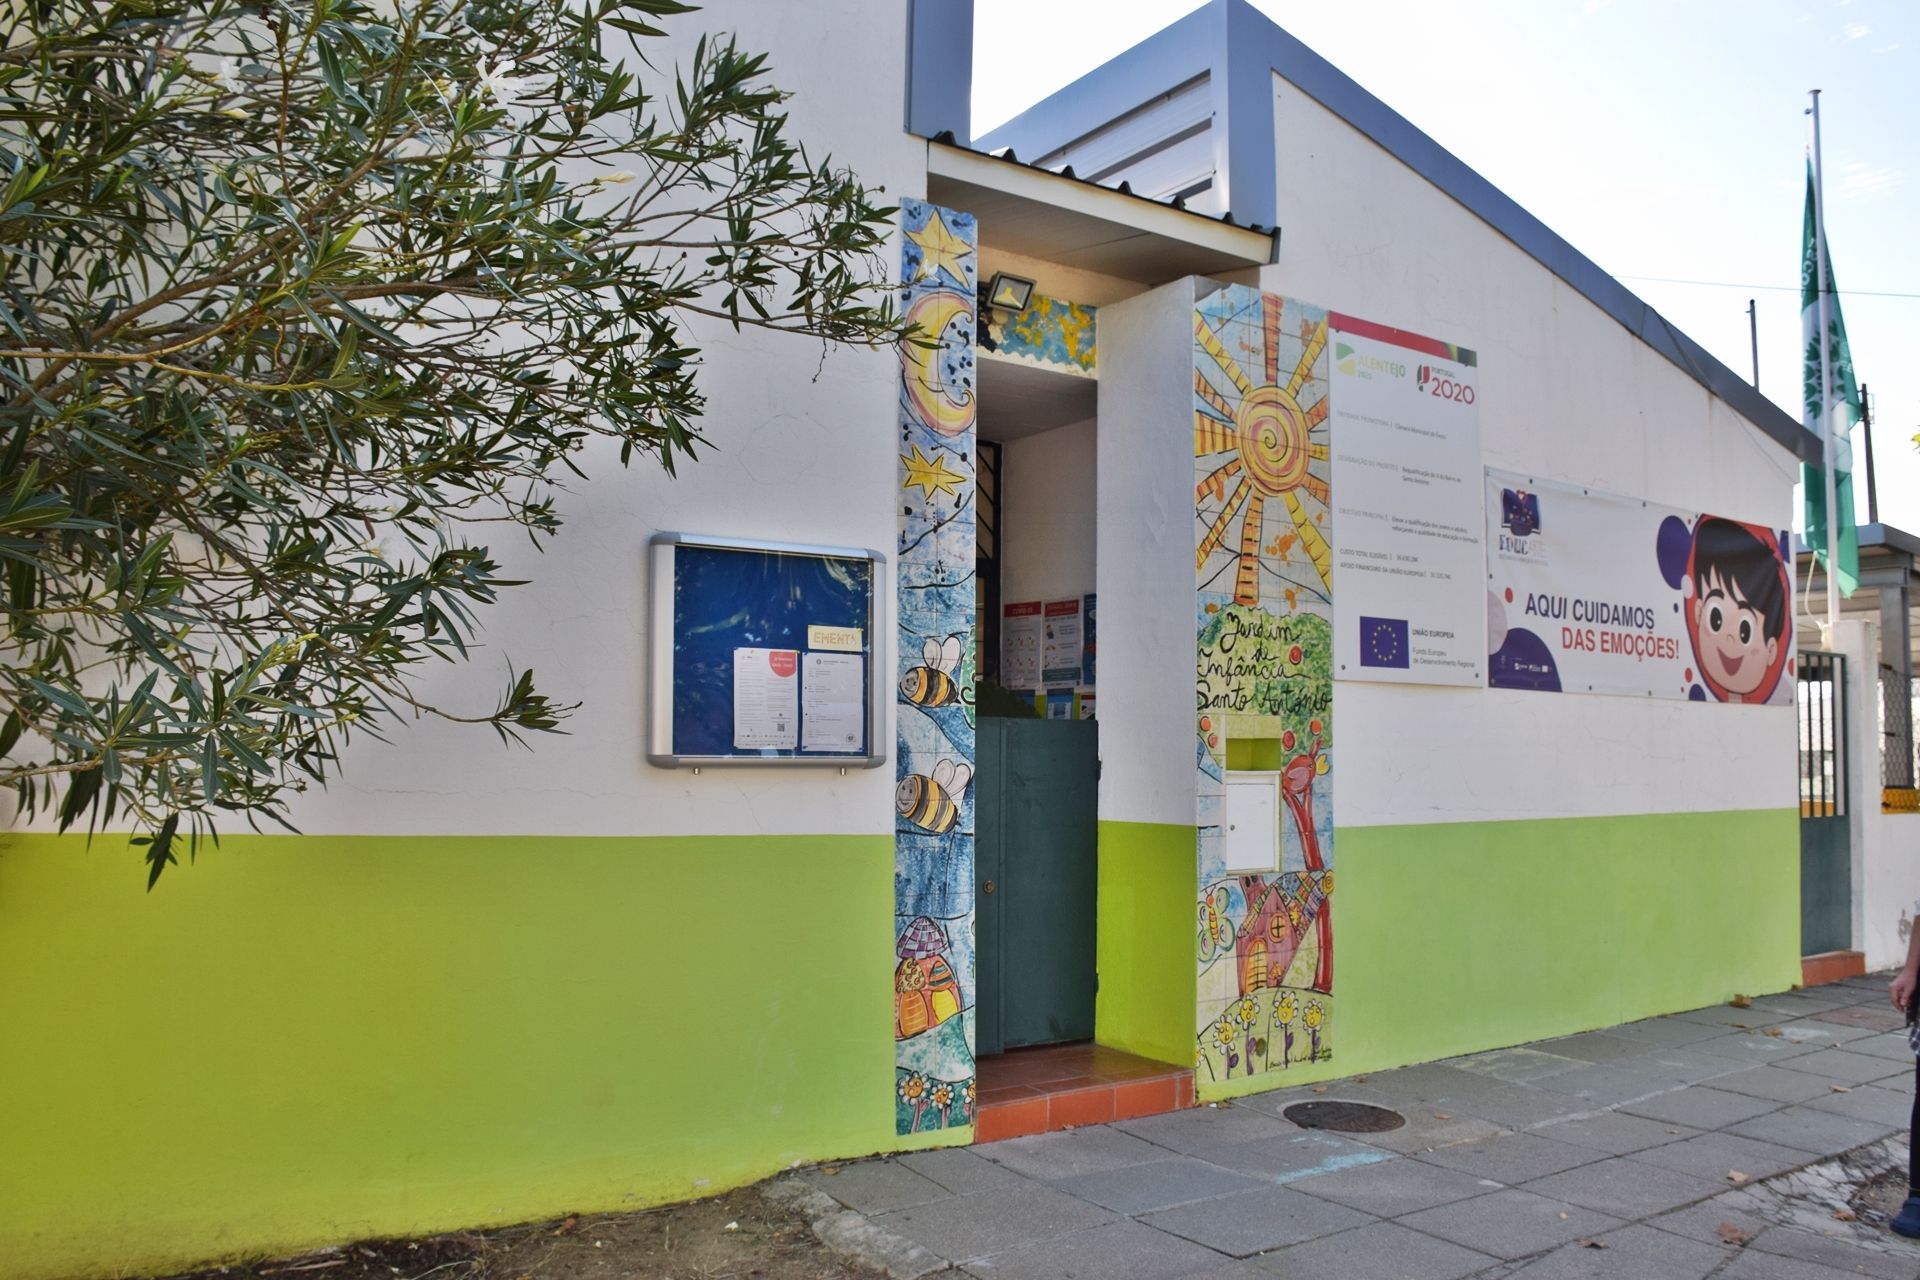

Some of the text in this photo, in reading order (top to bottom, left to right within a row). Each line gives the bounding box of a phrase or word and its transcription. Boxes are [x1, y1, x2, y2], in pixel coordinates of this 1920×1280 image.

[1358, 355, 1406, 378] ALENTEJO
[1431, 377, 1475, 405] 2020
[1524, 593, 1655, 630] AQUI CUIDAMOS
[1220, 611, 1301, 654] Jardim
[1412, 628, 1454, 639] UNIÃO EUROPEIA
[1562, 626, 1680, 662] DAS EMOÇÕES!
[1197, 647, 1312, 686] Infância
[1251, 640, 1279, 662] de
[1197, 679, 1333, 715] Santo António
